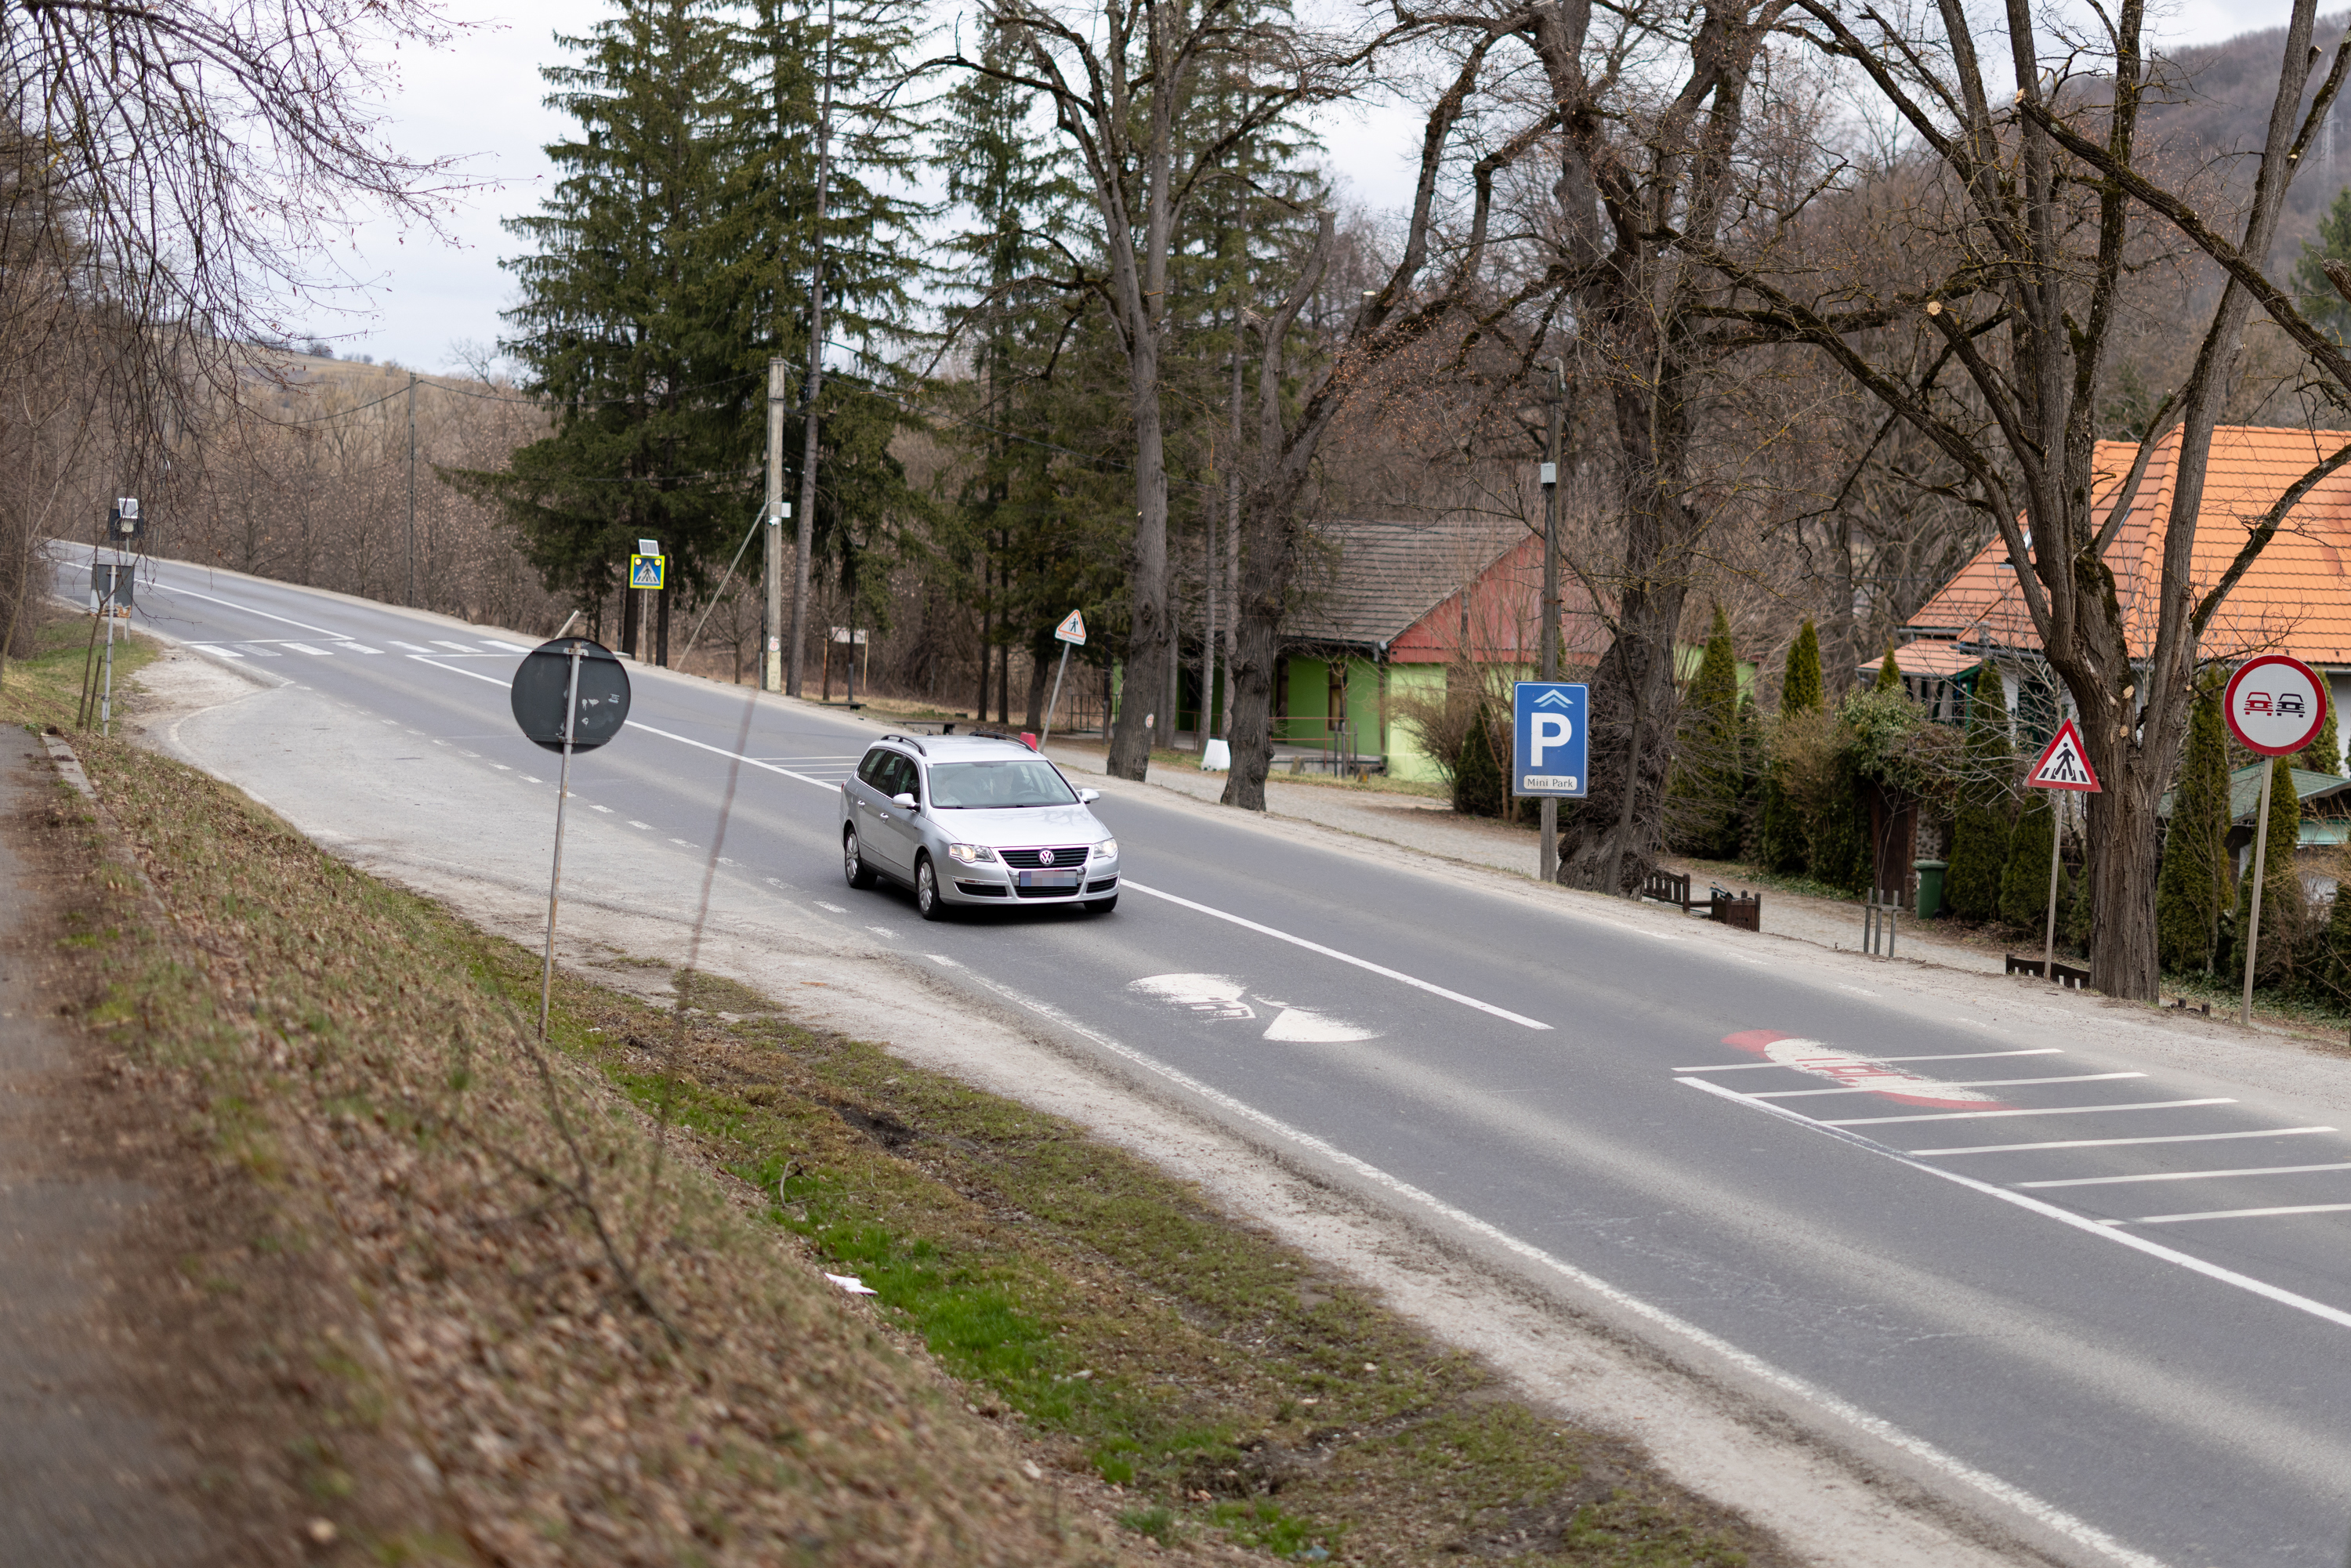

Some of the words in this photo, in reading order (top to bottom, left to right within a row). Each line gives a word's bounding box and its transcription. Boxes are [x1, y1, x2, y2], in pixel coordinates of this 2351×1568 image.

[1531, 712, 1572, 766] P
[1527, 778, 1549, 787] Mini
[1552, 778, 1574, 788] Park
